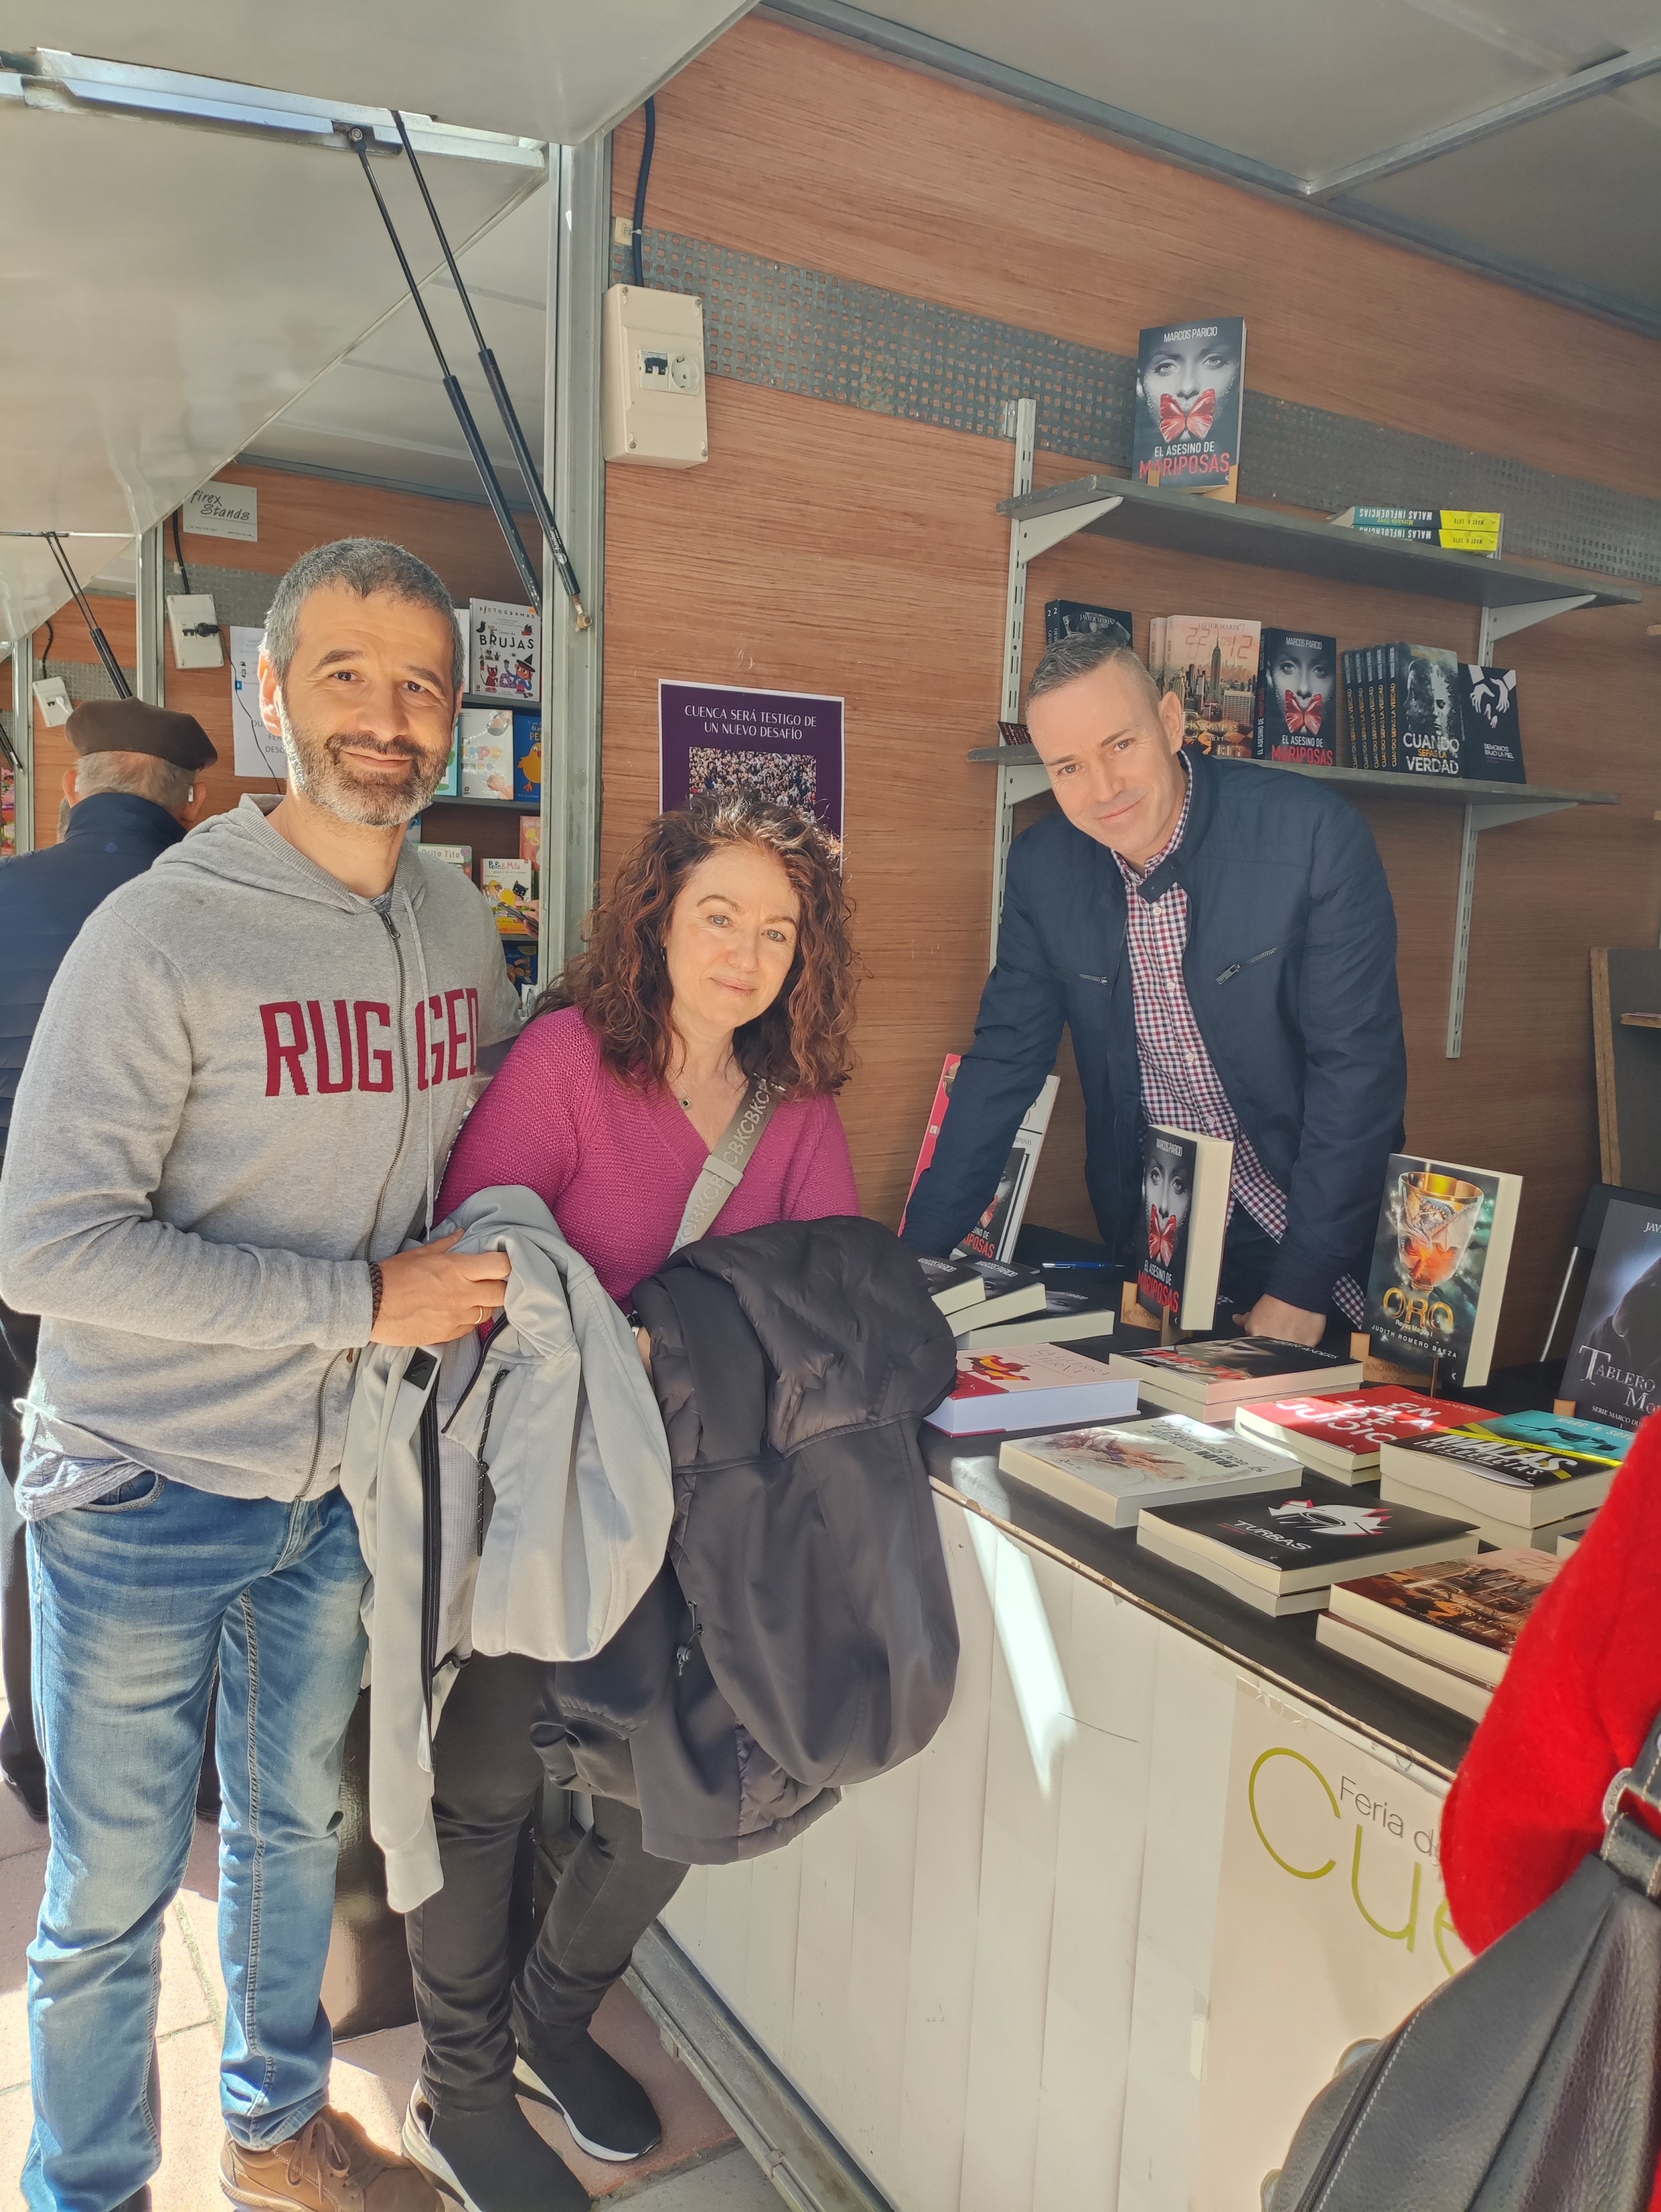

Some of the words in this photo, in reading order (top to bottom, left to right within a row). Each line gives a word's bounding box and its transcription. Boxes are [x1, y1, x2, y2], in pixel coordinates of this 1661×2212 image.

[1164, 329, 1191, 343] MARCOS
[1192, 326, 1218, 338] PARICIO
[1154, 446, 1164, 457] EL
[1166, 442, 1201, 456] ASESINO
[1204, 441, 1215, 452] DE
[1139, 452, 1230, 478] MARIPOSAS
[190, 490, 222, 507] firex
[200, 504, 250, 520] Stands
[1359, 508, 1407, 521] INFLUENCIAS
[1409, 510, 1433, 521] MALAS
[1394, 518, 1414, 526] Miranda
[1407, 529, 1432, 540] MALAS
[479, 605, 535, 619] PICTOGRAMAS
[1079, 613, 1097, 622] JAVIER
[479, 634, 534, 650] BRUJAS
[1286, 637, 1305, 648] MARCOS
[1305, 639, 1322, 651] PARICIO
[685, 705, 727, 720] CUENCA
[730, 708, 757, 722] SERÁ
[760, 711, 801, 726] TESTIGO
[804, 716, 817, 727] DE
[1259, 717, 1265, 725] DE
[1390, 710, 1396, 718] LA
[704, 721, 718, 733] UN
[722, 723, 757, 736] NUEVO
[760, 725, 802, 740] DESAFÍO
[1282, 735, 1290, 745] EL
[1290, 735, 1315, 747] ASESINO
[1316, 738, 1323, 748] DE
[1402, 732, 1460, 752] CUANDO
[1258, 748, 1263, 756] EL
[1271, 745, 1333, 767] MARIPOSAS
[1418, 748, 1438, 757] SEPAS
[1439, 751, 1447, 759] LA
[1405, 755, 1459, 775] VERDAD
[444, 850, 460, 858] Tito
[1156, 1138, 1169, 1152] MARCOS
[1169, 1143, 1182, 1157] PARICIO
[971, 1226, 983, 1238] SINO
[983, 1230, 990, 1240] DE
[1643, 1222, 1661, 1234] JAV
[963, 1233, 995, 1258] IPOSAS
[1144, 1259, 1149, 1271] EL
[1149, 1261, 1166, 1281] ASESINO
[1166, 1273, 1172, 1286] DE
[1137, 1269, 1179, 1313] MARIPOSAS
[1383, 1287, 1454, 1333] ORO
[1395, 1319, 1411, 1331] Reyes
[1412, 1325, 1430, 1337] Magos
[1372, 1325, 1395, 1337] JUDITH
[1398, 1333, 1429, 1349] ROMERO
[1432, 1346, 1457, 1358] BAEZA
[1301, 1347, 1339, 1359] ANDERS
[1579, 1345, 1655, 1393] TABLERO
[1592, 1405, 1609, 1419] SERIE
[1608, 1410, 1631, 1425] MARCO
[1593, 1425, 1602, 1433] R.
[1414, 1440, 1545, 1476] INFLUENCIAS
[1429, 1434, 1578, 1470] MALAS
[1234, 1520, 1312, 1550] TURBAS
[1340, 1775, 1405, 1839] Feria
[1249, 1747, 1459, 1977] Cue
